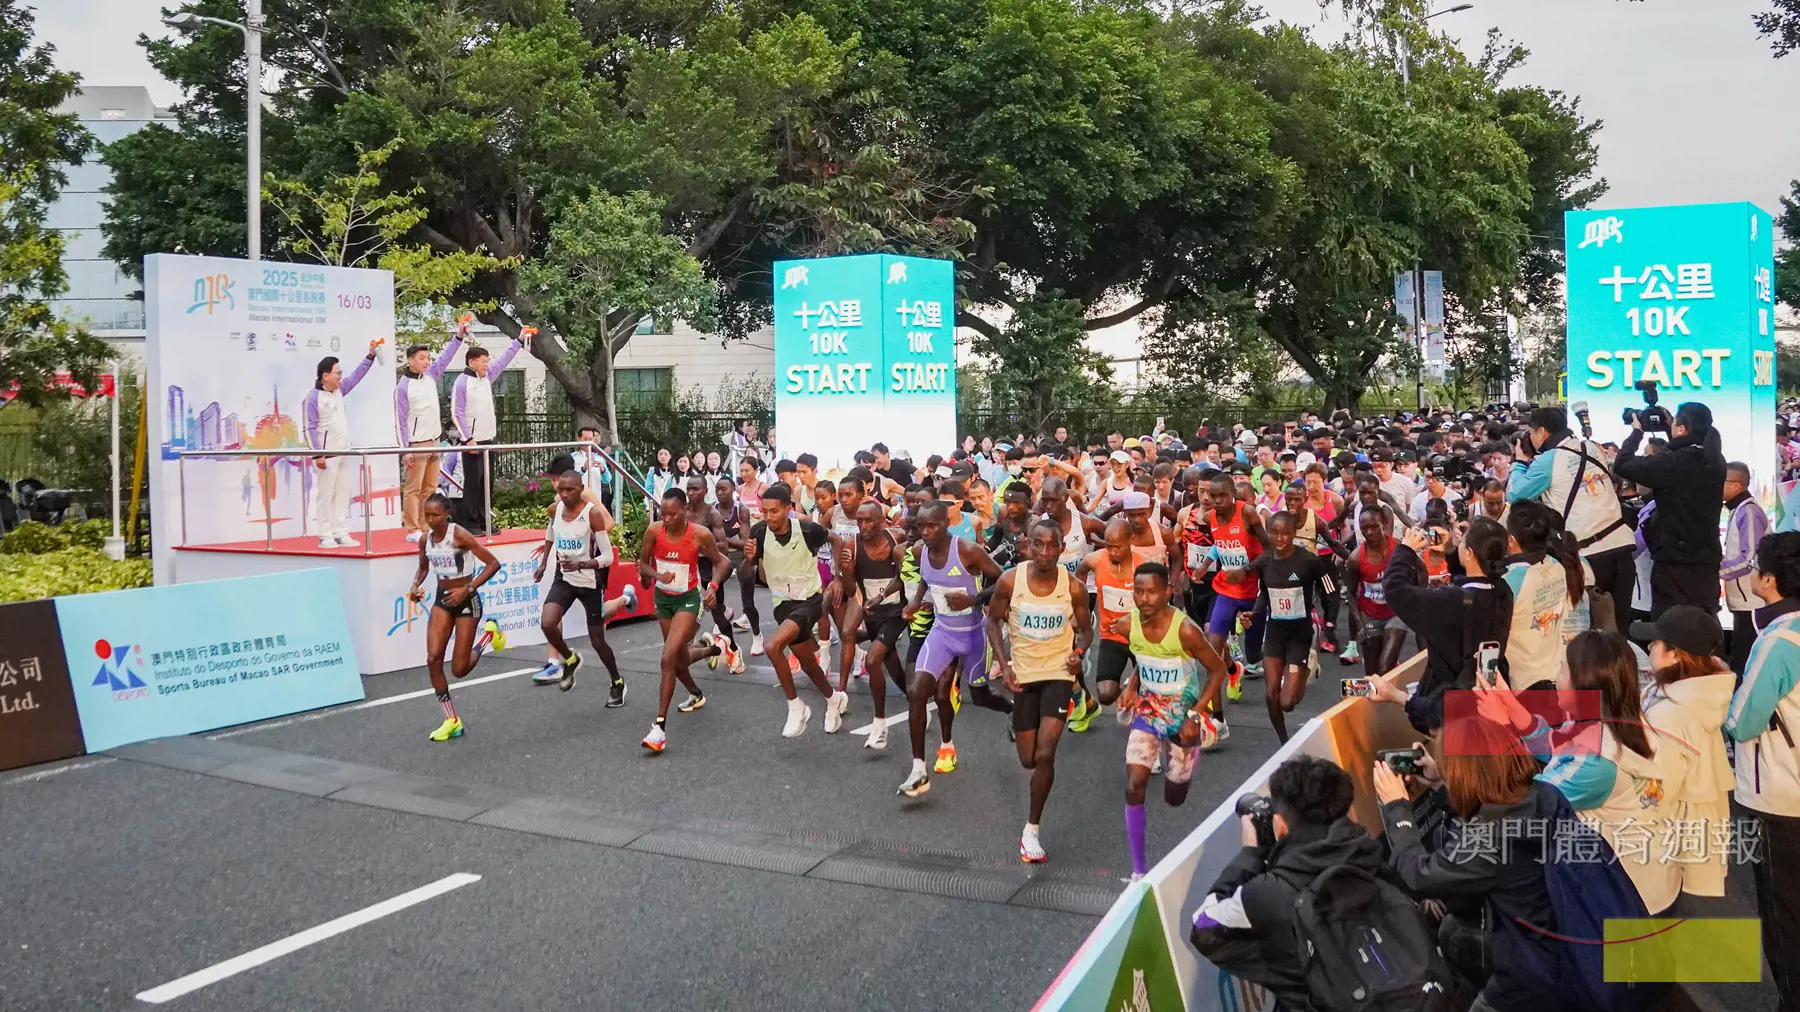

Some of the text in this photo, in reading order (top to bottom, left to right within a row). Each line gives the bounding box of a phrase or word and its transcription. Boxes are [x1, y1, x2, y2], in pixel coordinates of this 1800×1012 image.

[263, 269, 298, 287] 2025
[1599, 263, 1715, 302] 十公里
[337, 293, 372, 309] 16/03
[249, 313, 327, 324] Macao International 10K
[793, 300, 863, 330] 十公里
[896, 299, 943, 328] 十公里
[1625, 306, 1691, 337] 10K
[809, 332, 848, 355] 10K
[906, 332, 934, 353] 10K
[786, 363, 873, 393] START
[892, 362, 948, 392] START
[1586, 349, 1731, 388] START
[558, 539, 582, 550] A3386
[526, 604, 540, 614] 10K
[1117, 597, 1125, 608] 4
[1278, 598, 1291, 611] 58
[527, 617, 540, 627] 10K
[1023, 615, 1063, 629] A3389
[151, 634, 287, 667] 澳門特別行政區政府體育局
[154, 641, 341, 680] Instituto do Desporto do Governo da RAEM
[0, 656, 42, 687] 公司
[157, 682, 190, 696] Sports
[192, 677, 226, 689] Bureau
[228, 672, 238, 683] of
[240, 669, 269, 680] Macao
[271, 664, 290, 676] SAR
[292, 656, 344, 672] Government
[1141, 666, 1178, 684] A1277
[0, 691, 40, 714] Ltd.
